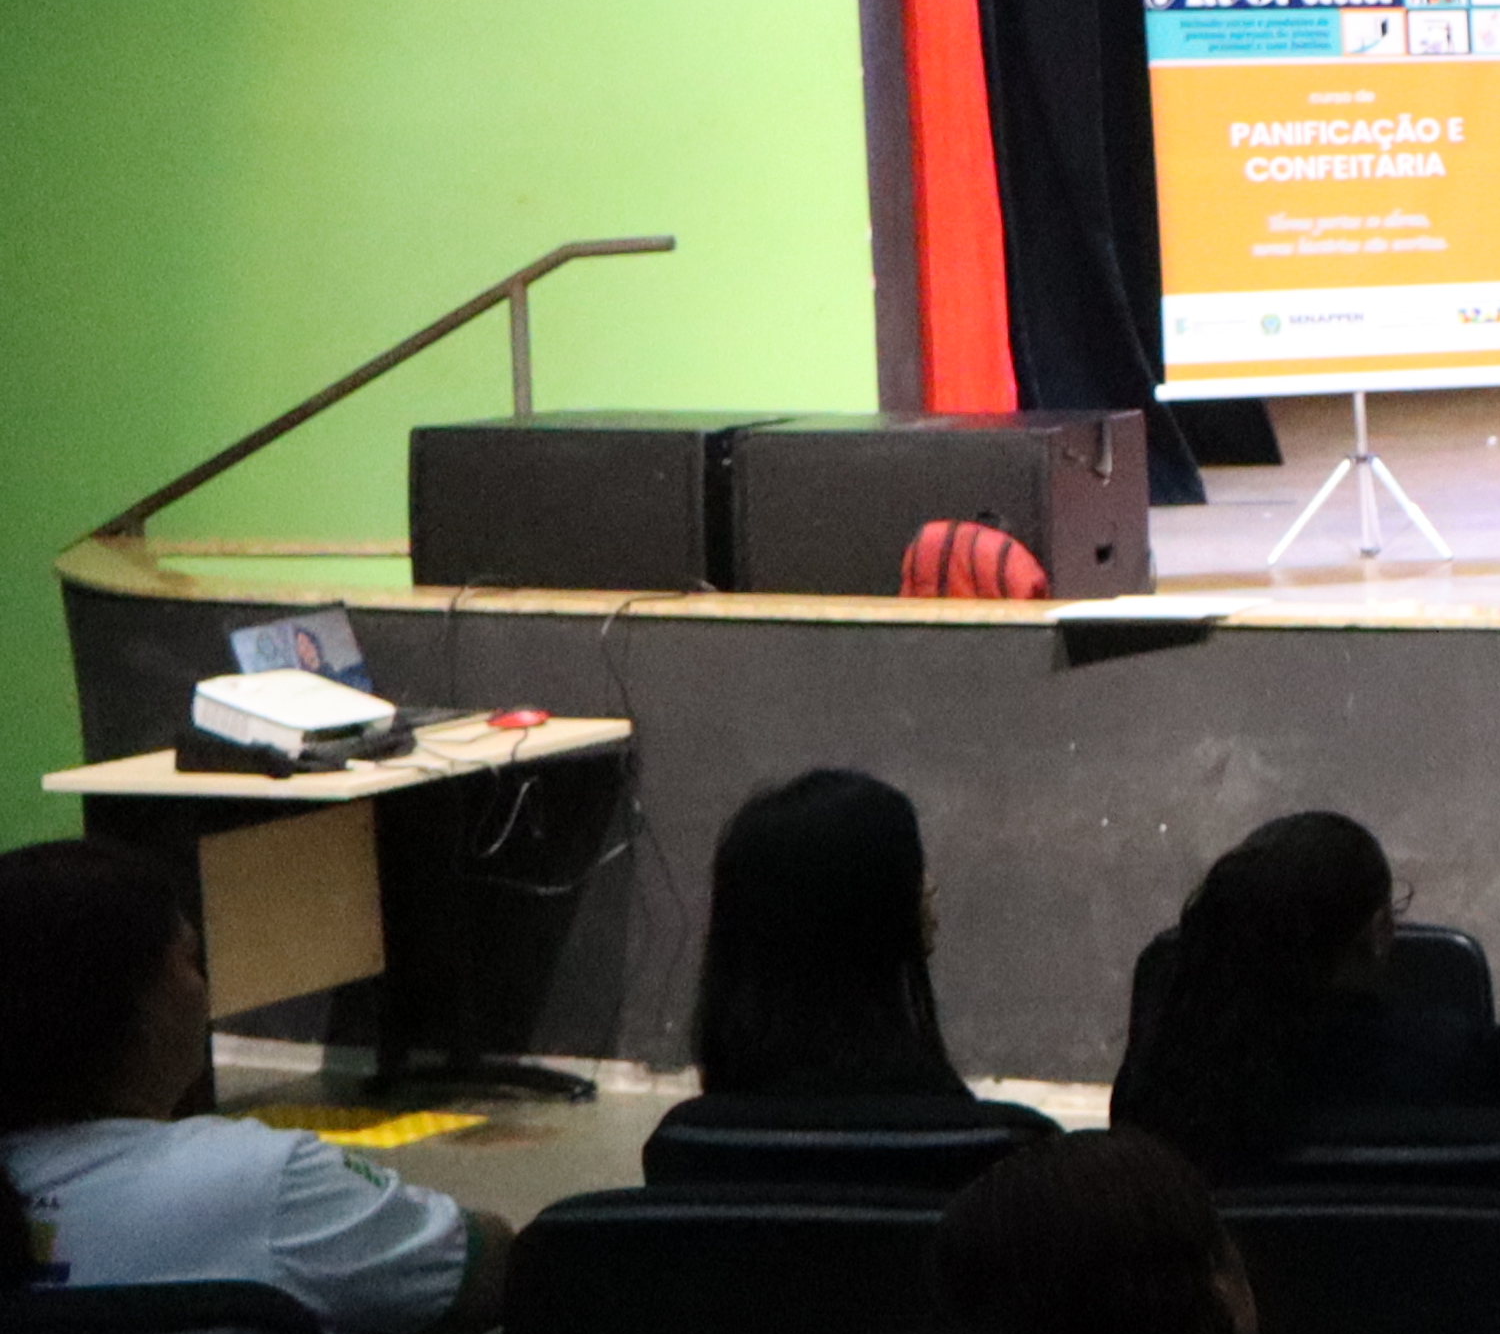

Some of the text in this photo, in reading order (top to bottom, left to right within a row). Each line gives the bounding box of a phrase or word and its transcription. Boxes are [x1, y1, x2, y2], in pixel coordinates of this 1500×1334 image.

[1230, 113, 1465, 152] PANIFICAÇÃO E
[1244, 152, 1446, 181] CONFEITARIA
